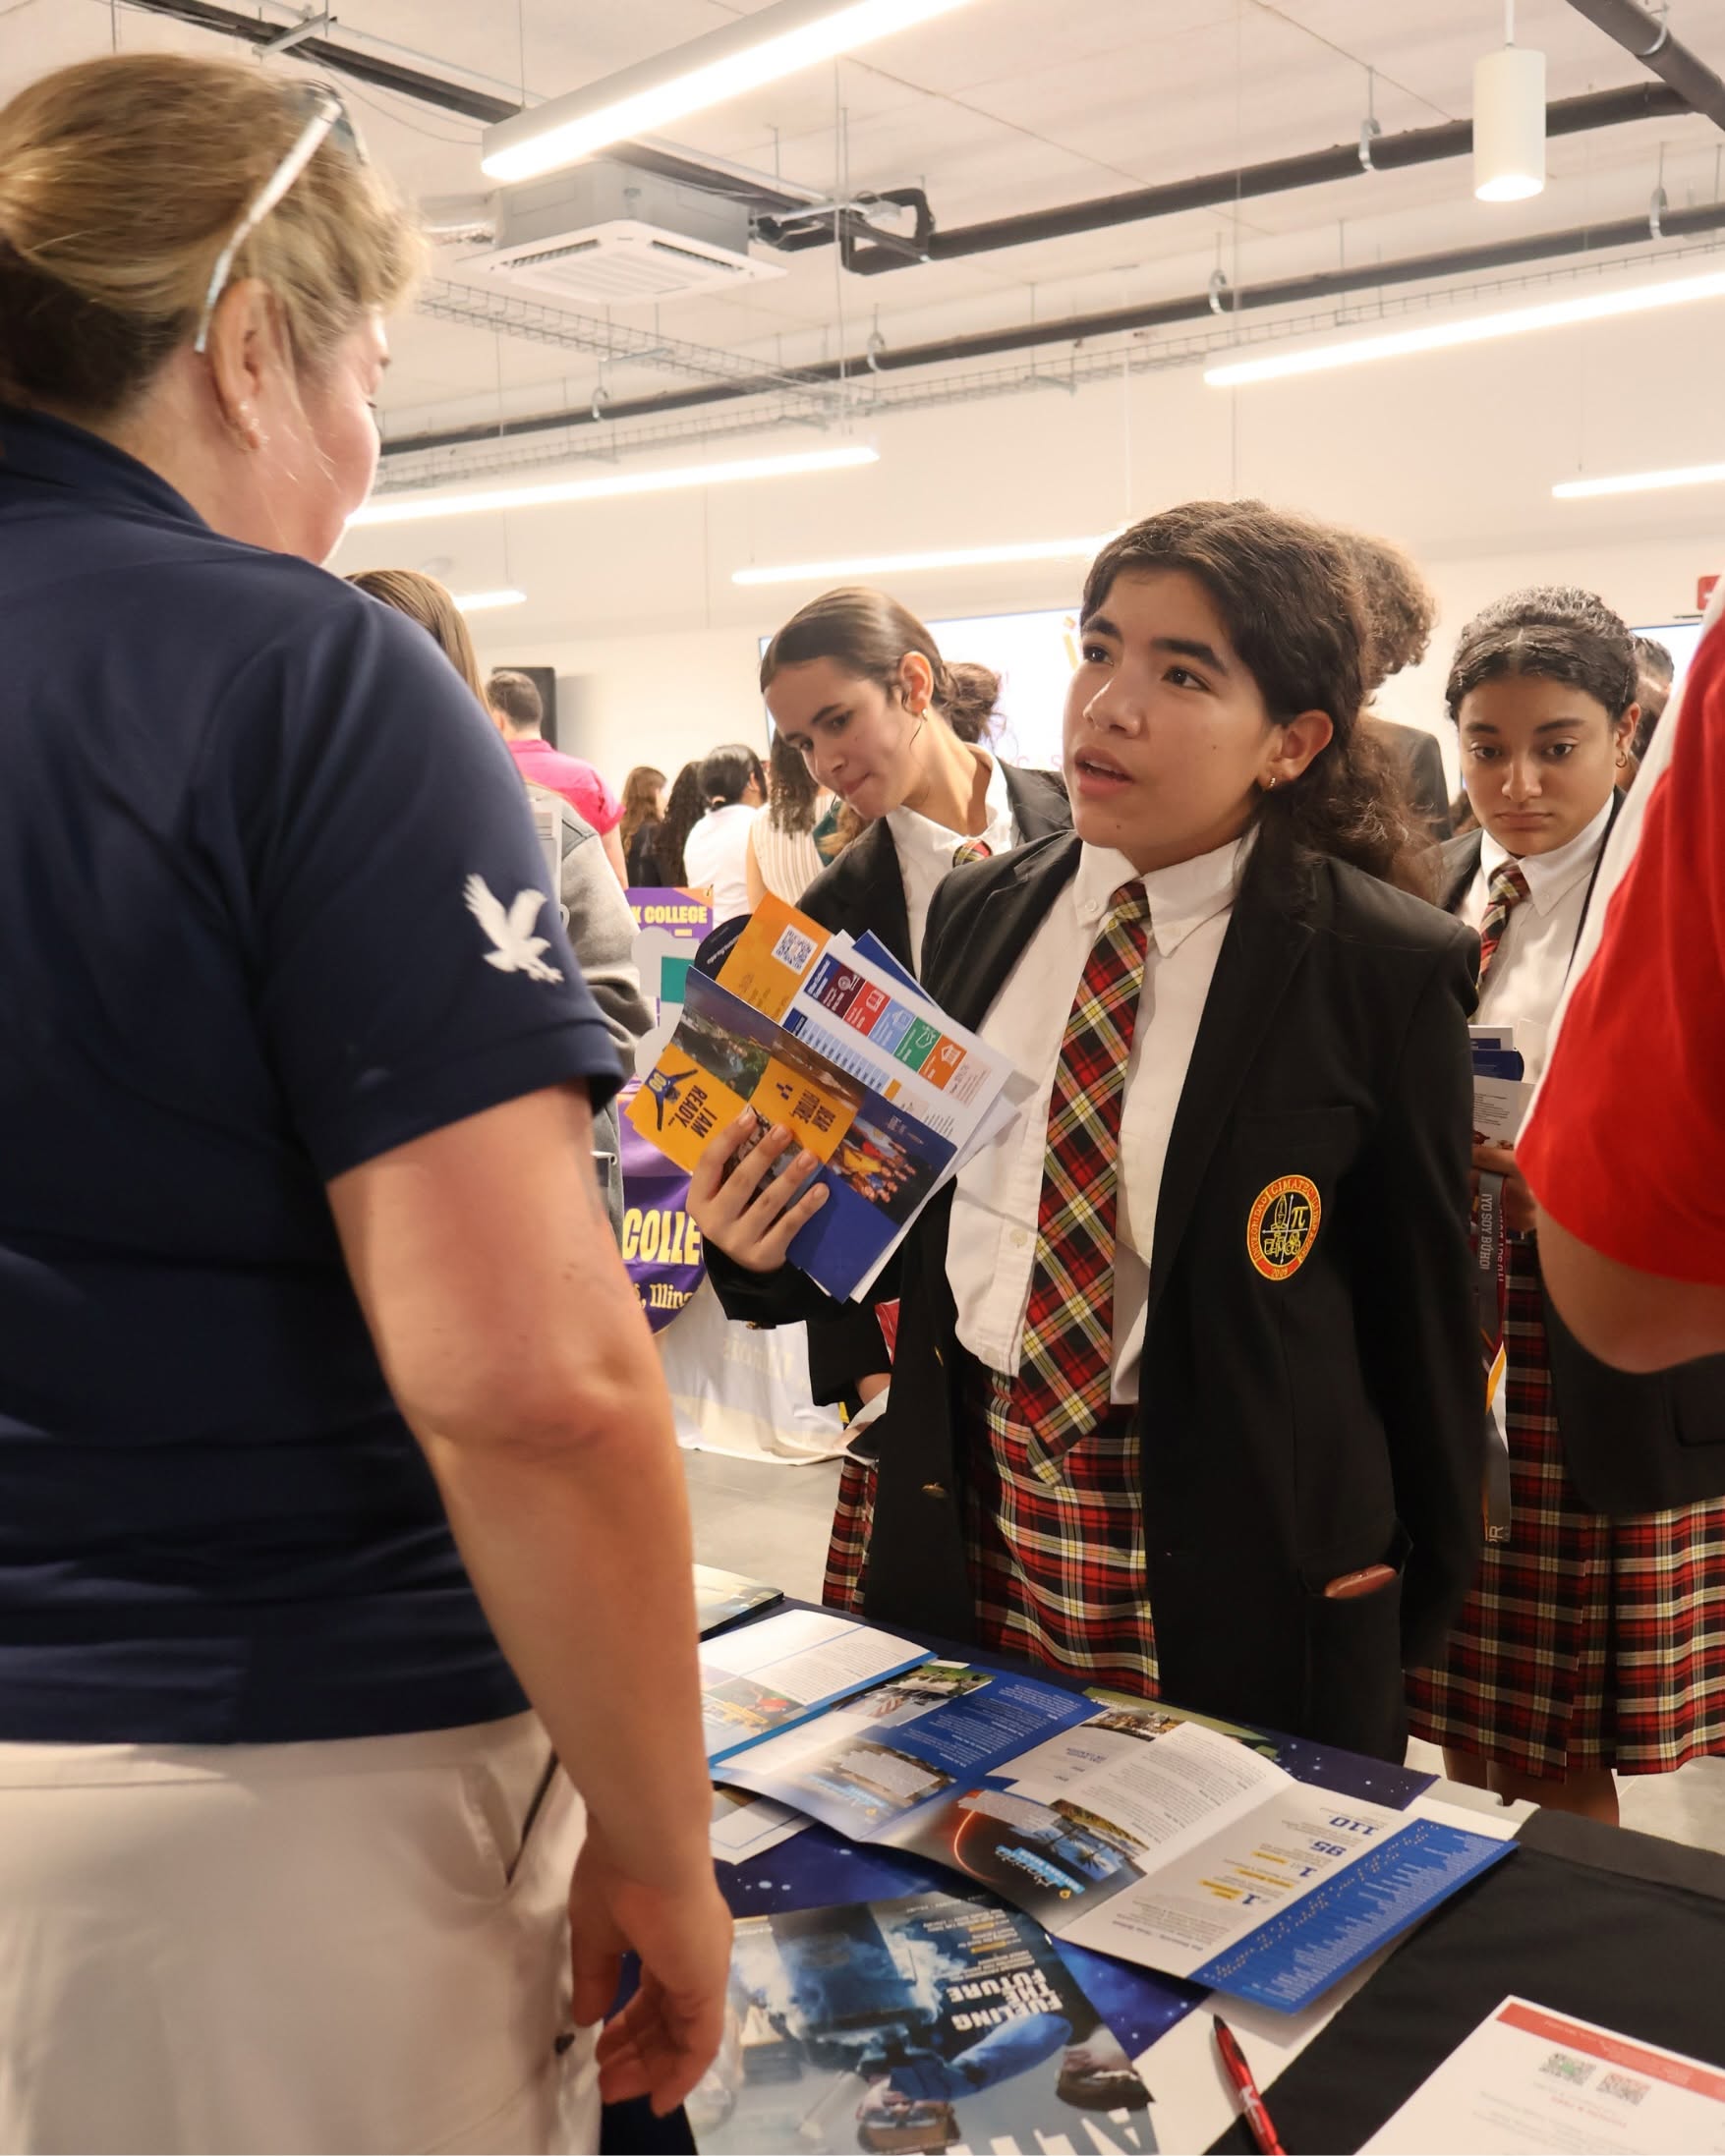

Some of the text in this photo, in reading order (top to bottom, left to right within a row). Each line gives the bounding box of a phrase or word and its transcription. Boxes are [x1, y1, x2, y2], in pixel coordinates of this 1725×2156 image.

[644, 905, 708, 924] COLLEGE
[690, 1106, 718, 1139] I AM
[1481, 1213, 1493, 1234] SOY
[1329, 1817, 1379, 1835] 110
[1310, 1841, 1347, 1856] 95
[947, 1968, 1047, 2004] FUTURE
[1005, 1981, 1053, 2006] THE
[950, 1990, 1064, 2031] FUELING
